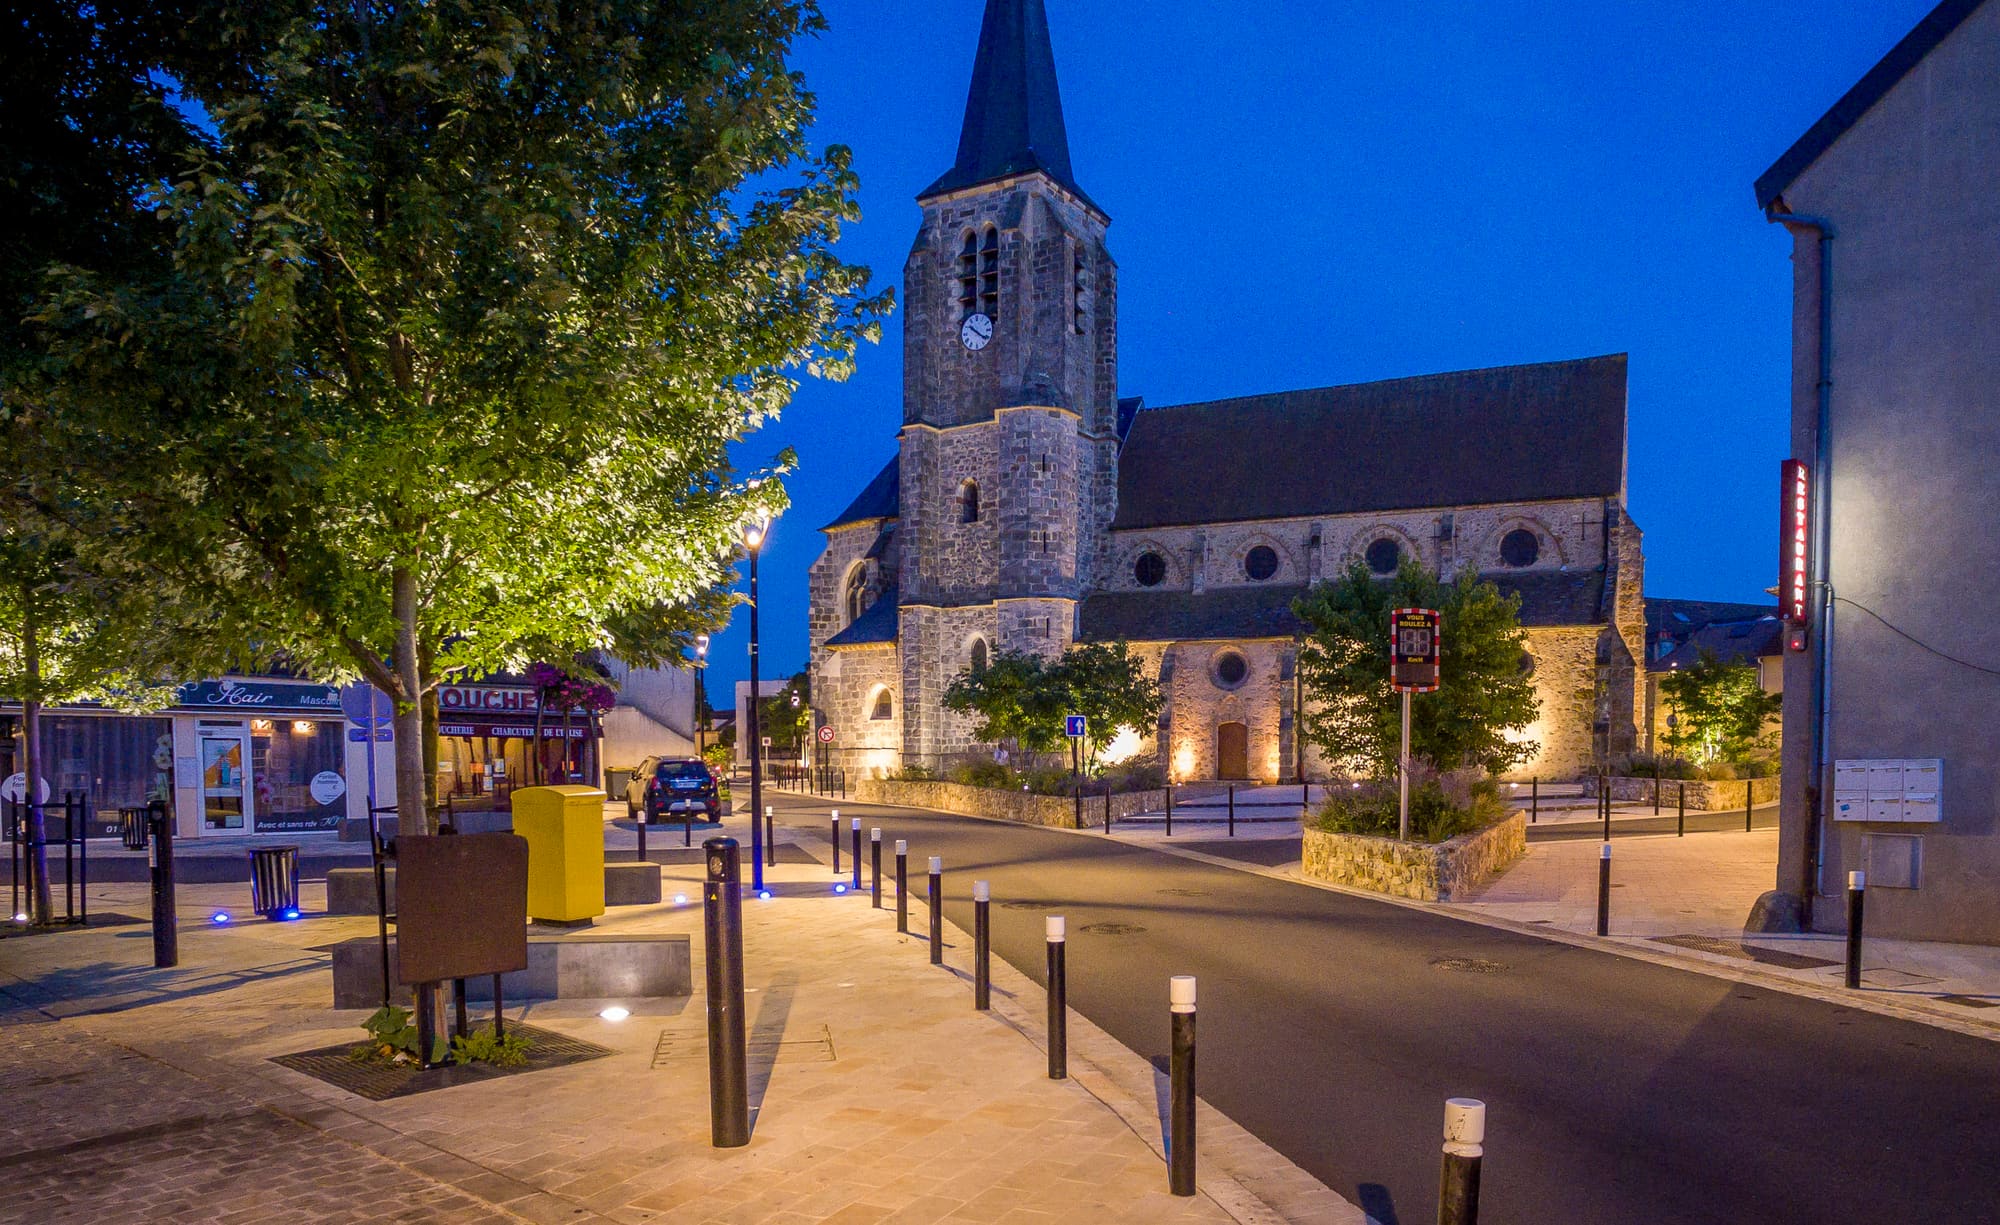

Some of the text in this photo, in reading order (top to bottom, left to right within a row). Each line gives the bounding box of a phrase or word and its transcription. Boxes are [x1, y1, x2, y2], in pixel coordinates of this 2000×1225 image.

[1794, 466, 1806, 616] RESTAURANT
[438, 688, 538, 709] OUCHE
[491, 727, 535, 736] CHARCUTER
[543, 728, 554, 736] DE
[257, 821, 277, 829] Avec
[304, 820, 318, 828] rdv
